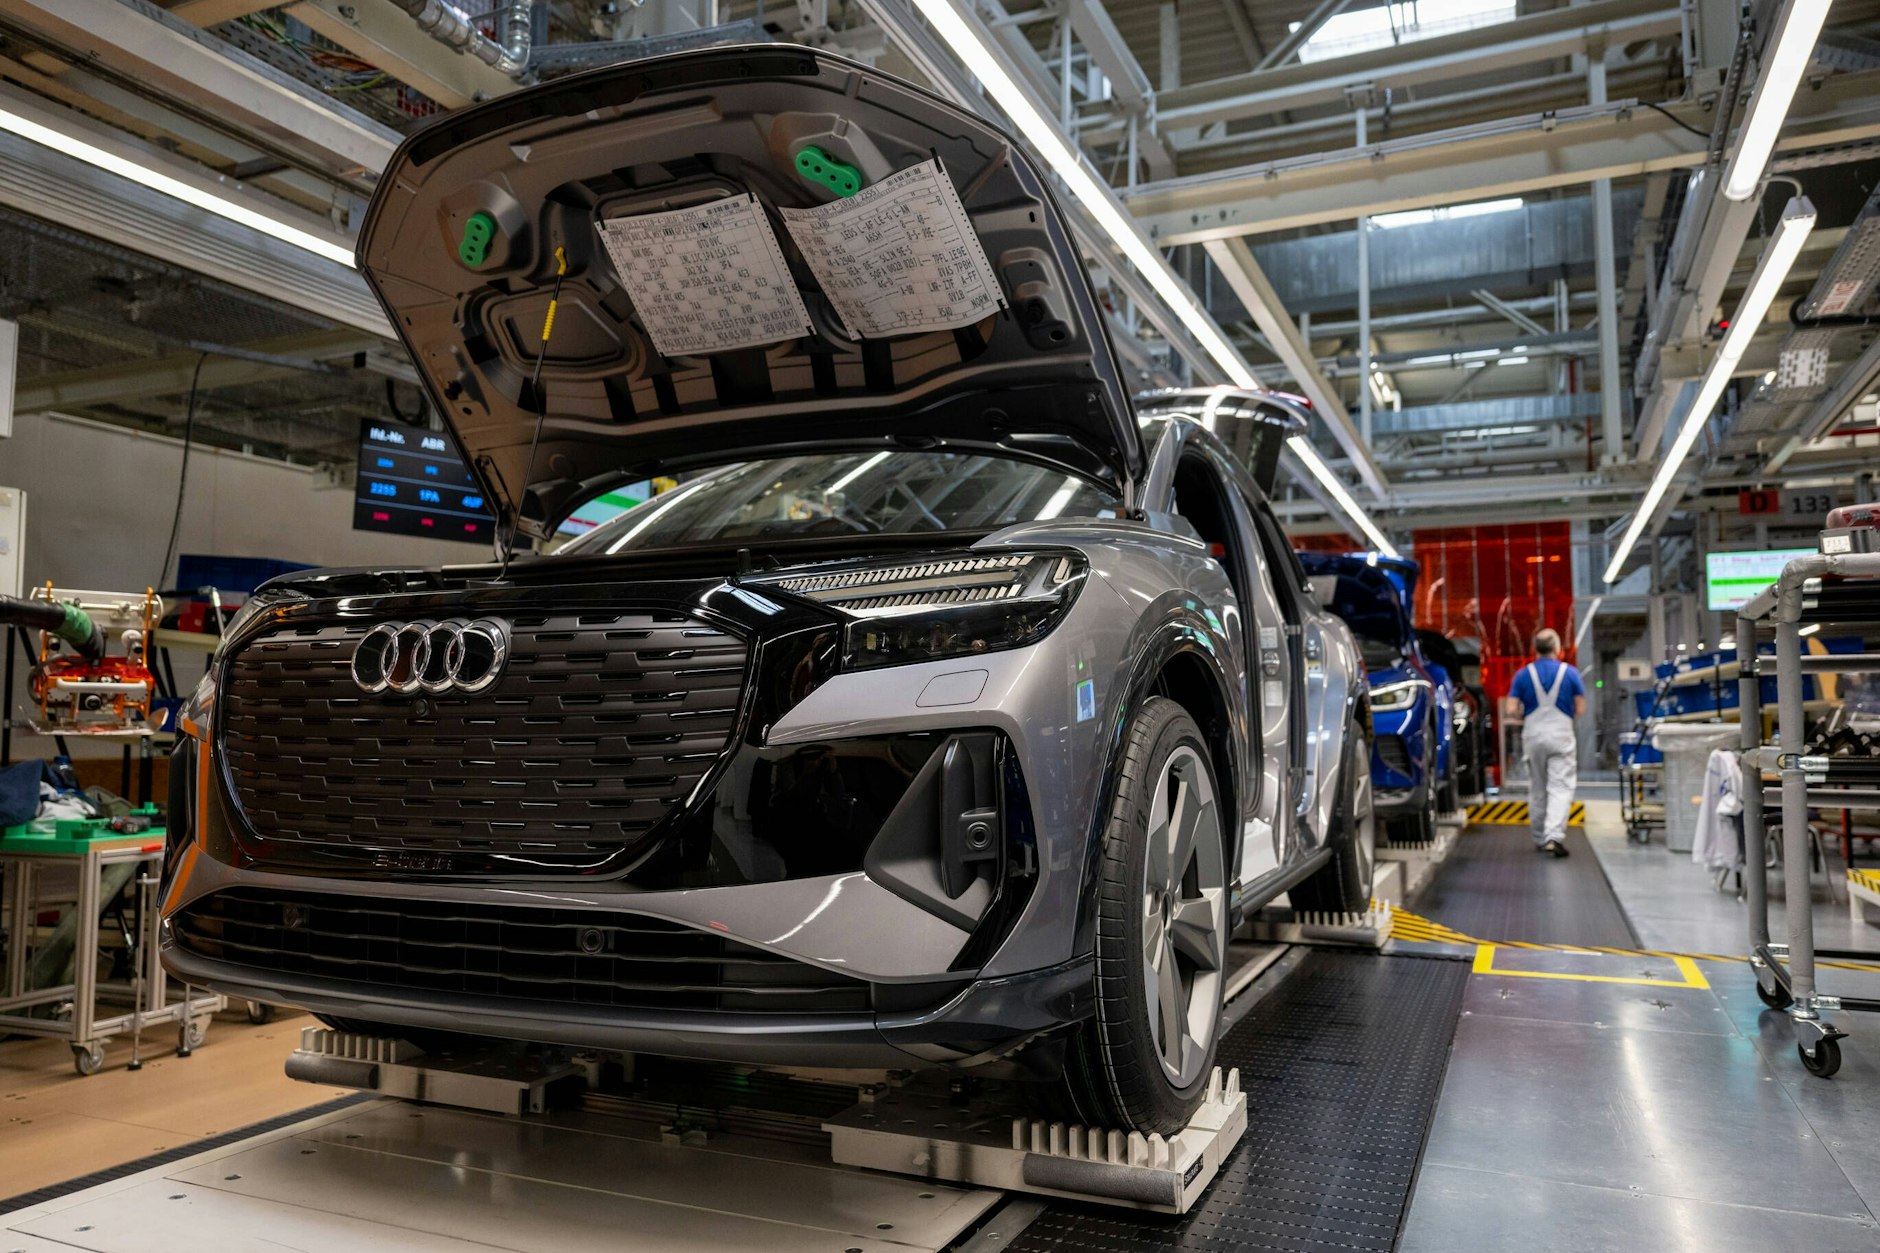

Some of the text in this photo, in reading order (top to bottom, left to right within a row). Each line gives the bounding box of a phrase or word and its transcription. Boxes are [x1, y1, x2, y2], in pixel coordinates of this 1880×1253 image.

[859, 189, 876, 200] 2255
[960, 270, 976, 285] A-FF
[971, 293, 989, 307] NORM
[1752, 494, 1768, 513] D
[1793, 496, 1831, 514] 133
